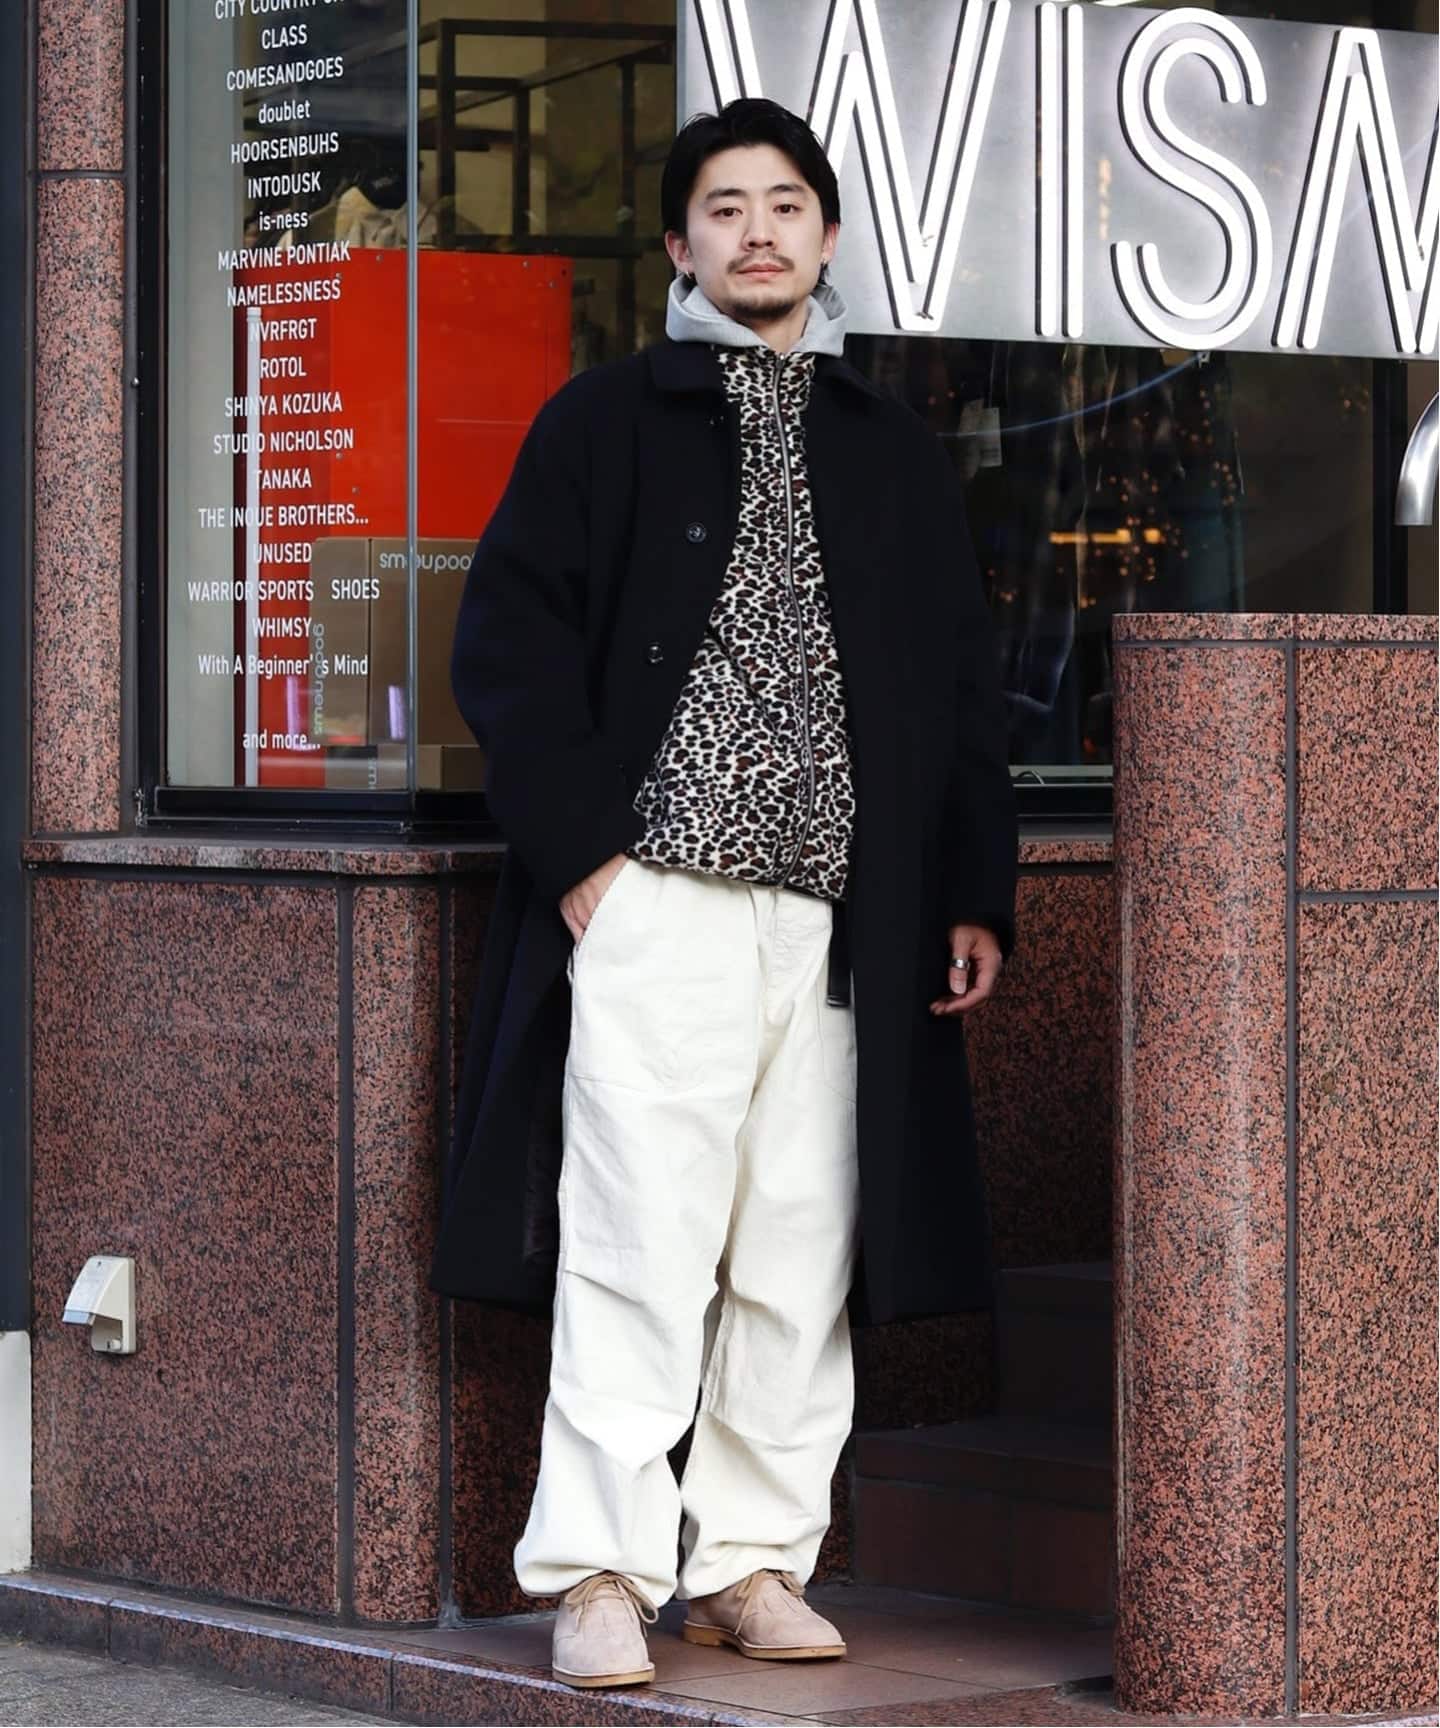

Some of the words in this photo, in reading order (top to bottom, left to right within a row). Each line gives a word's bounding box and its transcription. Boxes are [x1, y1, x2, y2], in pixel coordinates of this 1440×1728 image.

[215, 0, 246, 19] CITY
[261, 24, 307, 49] CLASS
[227, 56, 343, 90] COMESANDGOES
[258, 100, 310, 124] doublet
[231, 132, 339, 163] HOORSENBUHS
[248, 171, 321, 199] INTODUSK
[259, 211, 308, 231] is-ness
[218, 246, 282, 271] MARVINE
[287, 240, 350, 266] PONTIAK
[227, 279, 341, 307] NAMELESSNESS
[250, 318, 317, 342] NVRFRGT
[260, 356, 307, 379] ROTOL
[225, 395, 278, 417] SHINYA
[282, 391, 342, 415] KOZUKA
[213, 432, 265, 455] STUDIO
[270, 428, 354, 452] NICHOLSON
[254, 467, 312, 490] TANAKA
[199, 507, 225, 528] THE
[230, 506, 273, 527] INOUE
[278, 504, 368, 527] BROTHERS...
[253, 542, 312, 564] UNUSED
[188, 581, 252, 601] WARRIOR
[258, 580, 314, 601] SPORTS
[331, 579, 380, 600] SHOES
[252, 617, 312, 638] WHIMSY
[199, 655, 228, 675] With
[233, 656, 244, 674] A
[334, 655, 368, 675] Mind
[243, 730, 267, 749] and
[272, 733, 321, 750] more...
